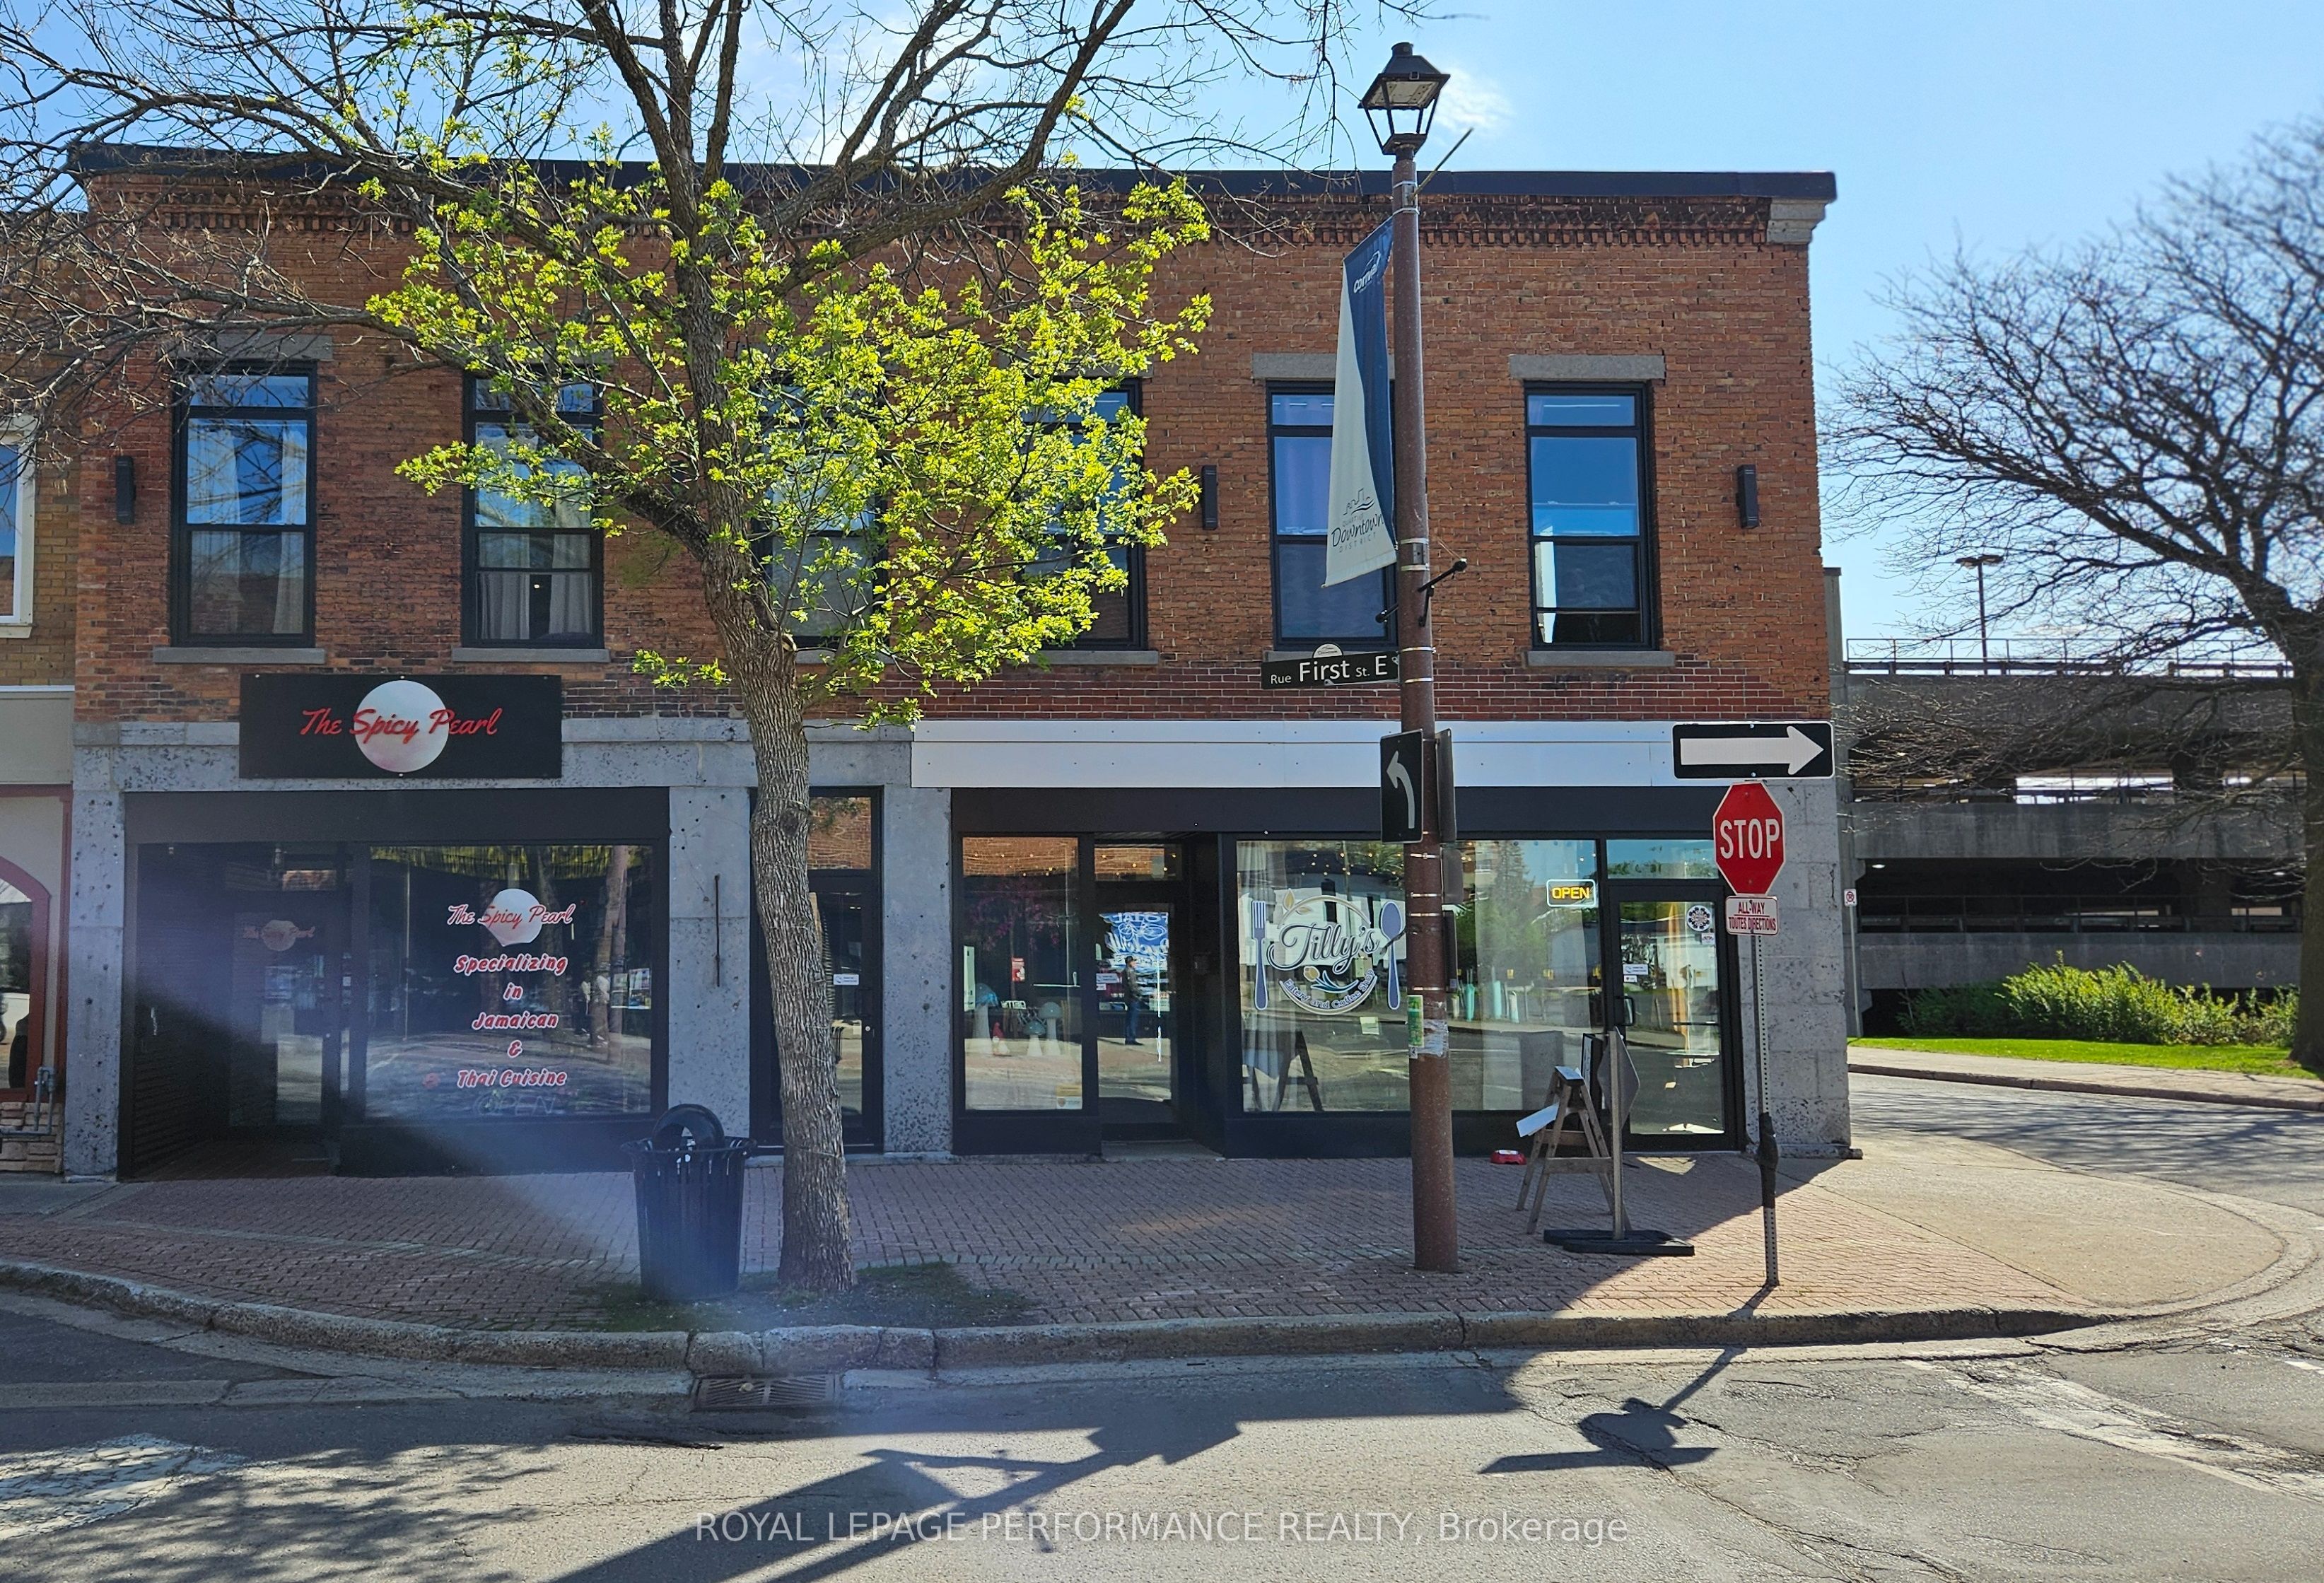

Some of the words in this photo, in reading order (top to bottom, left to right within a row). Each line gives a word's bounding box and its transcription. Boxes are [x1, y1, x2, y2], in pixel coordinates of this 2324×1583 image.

[1331, 514, 1384, 547] Downtown
[1271, 674, 1292, 684] Rue
[1300, 660, 1350, 682] First
[1355, 667, 1370, 677] St.
[1375, 655, 1387, 675] E
[300, 708, 342, 735] The
[349, 708, 420, 744] Spicy
[428, 708, 503, 735] Pearl
[1720, 818, 1780, 859] STOP
[1551, 887, 1590, 899] OPEN
[448, 904, 475, 924] The
[478, 905, 523, 929] Spicy
[529, 903, 576, 924] Pearl
[1739, 901, 1765, 914] ALL-WAY
[1729, 917, 1746, 930] TOUTES
[1748, 918, 1776, 930] DIRECTIONS
[1266, 921, 1380, 974] Tilly's
[454, 954, 568, 976] Specializing
[503, 982, 523, 1000] in
[1284, 979, 1310, 1001] Eatery
[1310, 1000, 1329, 1008] and
[1331, 991, 1361, 1009] Coffee
[1358, 969, 1374, 991] Shop
[472, 1011, 559, 1029] Jamaican
[508, 1040, 522, 1058] &
[457, 1070, 498, 1087] Thai
[499, 1068, 567, 1086] Cuisine
[477, 1095, 556, 1116] OPEN
